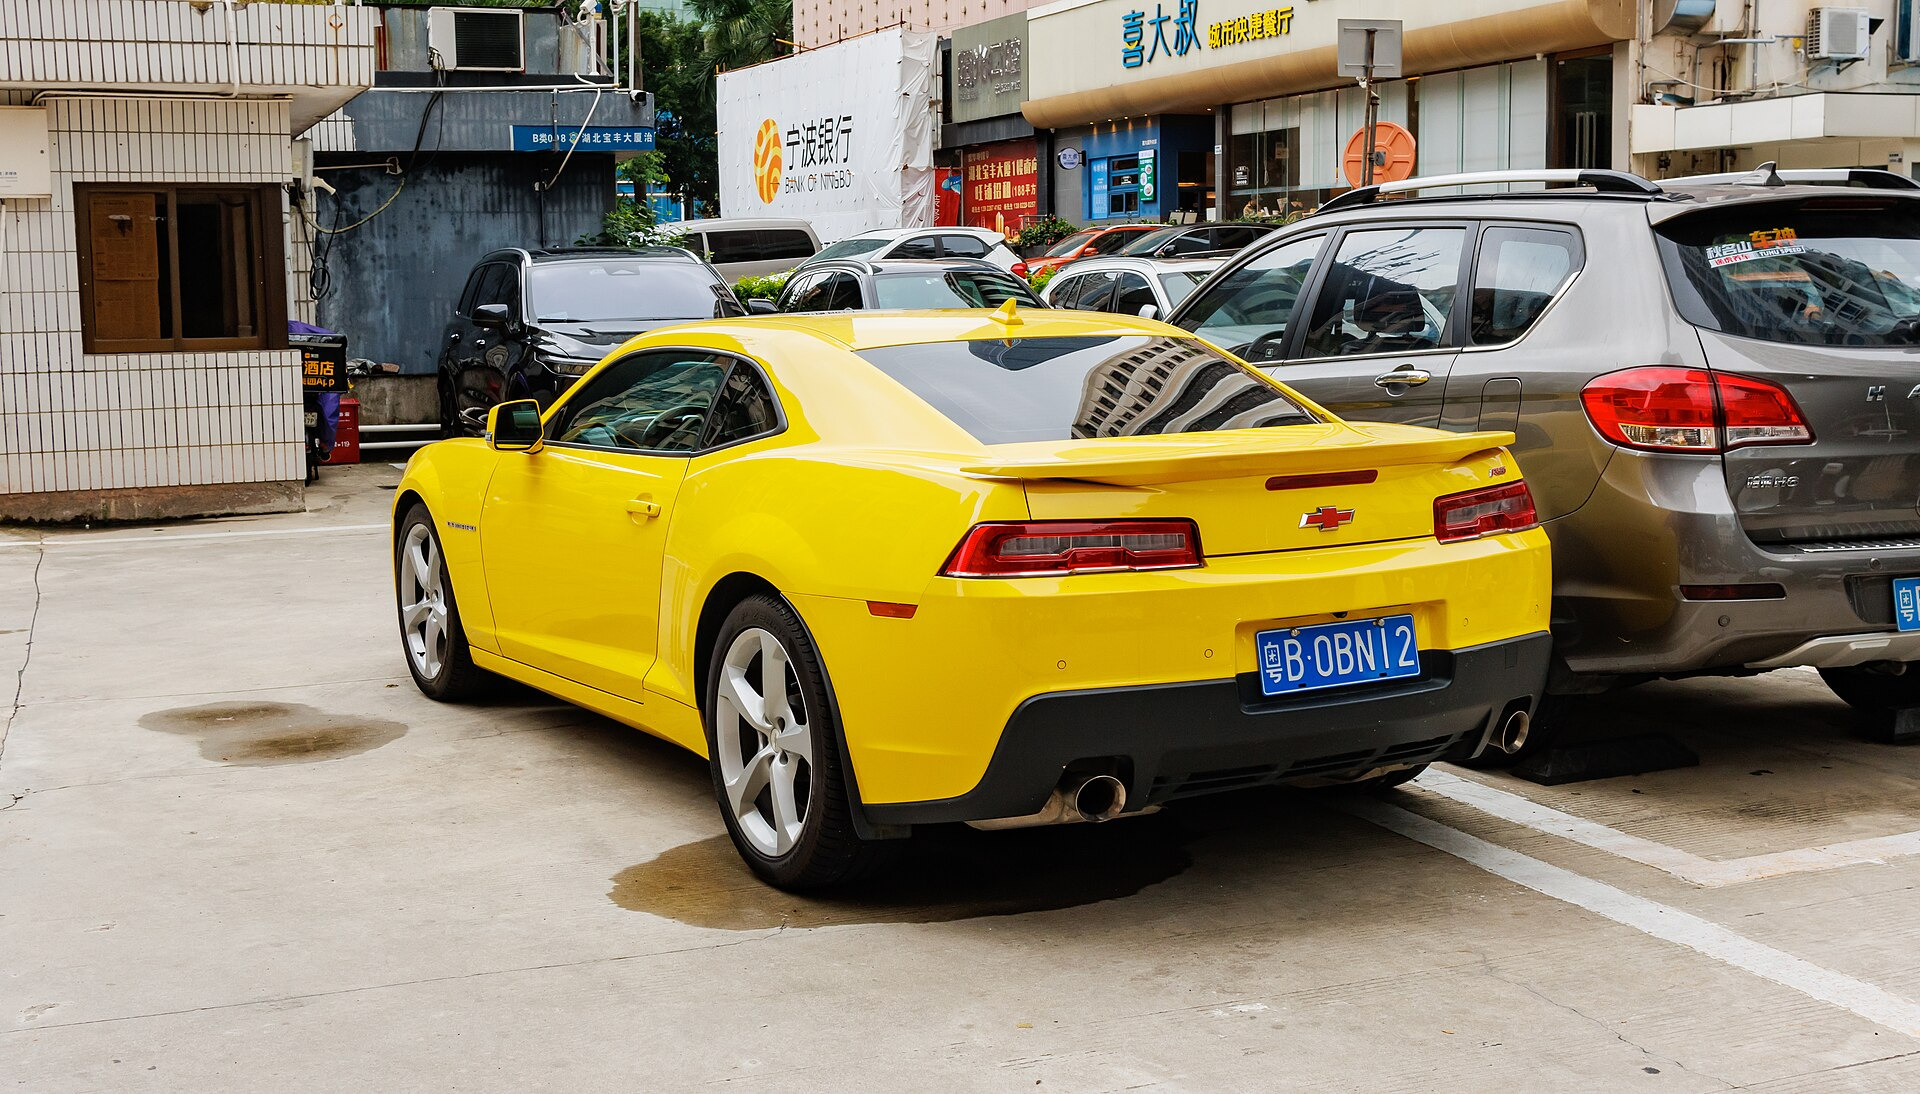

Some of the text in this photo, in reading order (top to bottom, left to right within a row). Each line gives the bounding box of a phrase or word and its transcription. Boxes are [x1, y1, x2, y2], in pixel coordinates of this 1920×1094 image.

[1121, 0, 1294, 68] 喜大叔 城市快捷餐厅
[582, 132, 653, 143] 湖北宝丰大厦治
[786, 114, 852, 171] 宁波银行
[785, 169, 851, 194] BANK OF NINGBO
[1705, 226, 1797, 260] 秋名山 车神
[1759, 249, 1780, 258] TUHU
[1780, 246, 1803, 255] SPEED
[303, 360, 335, 376] 酒店
[1774, 475, 1800, 488] H6
